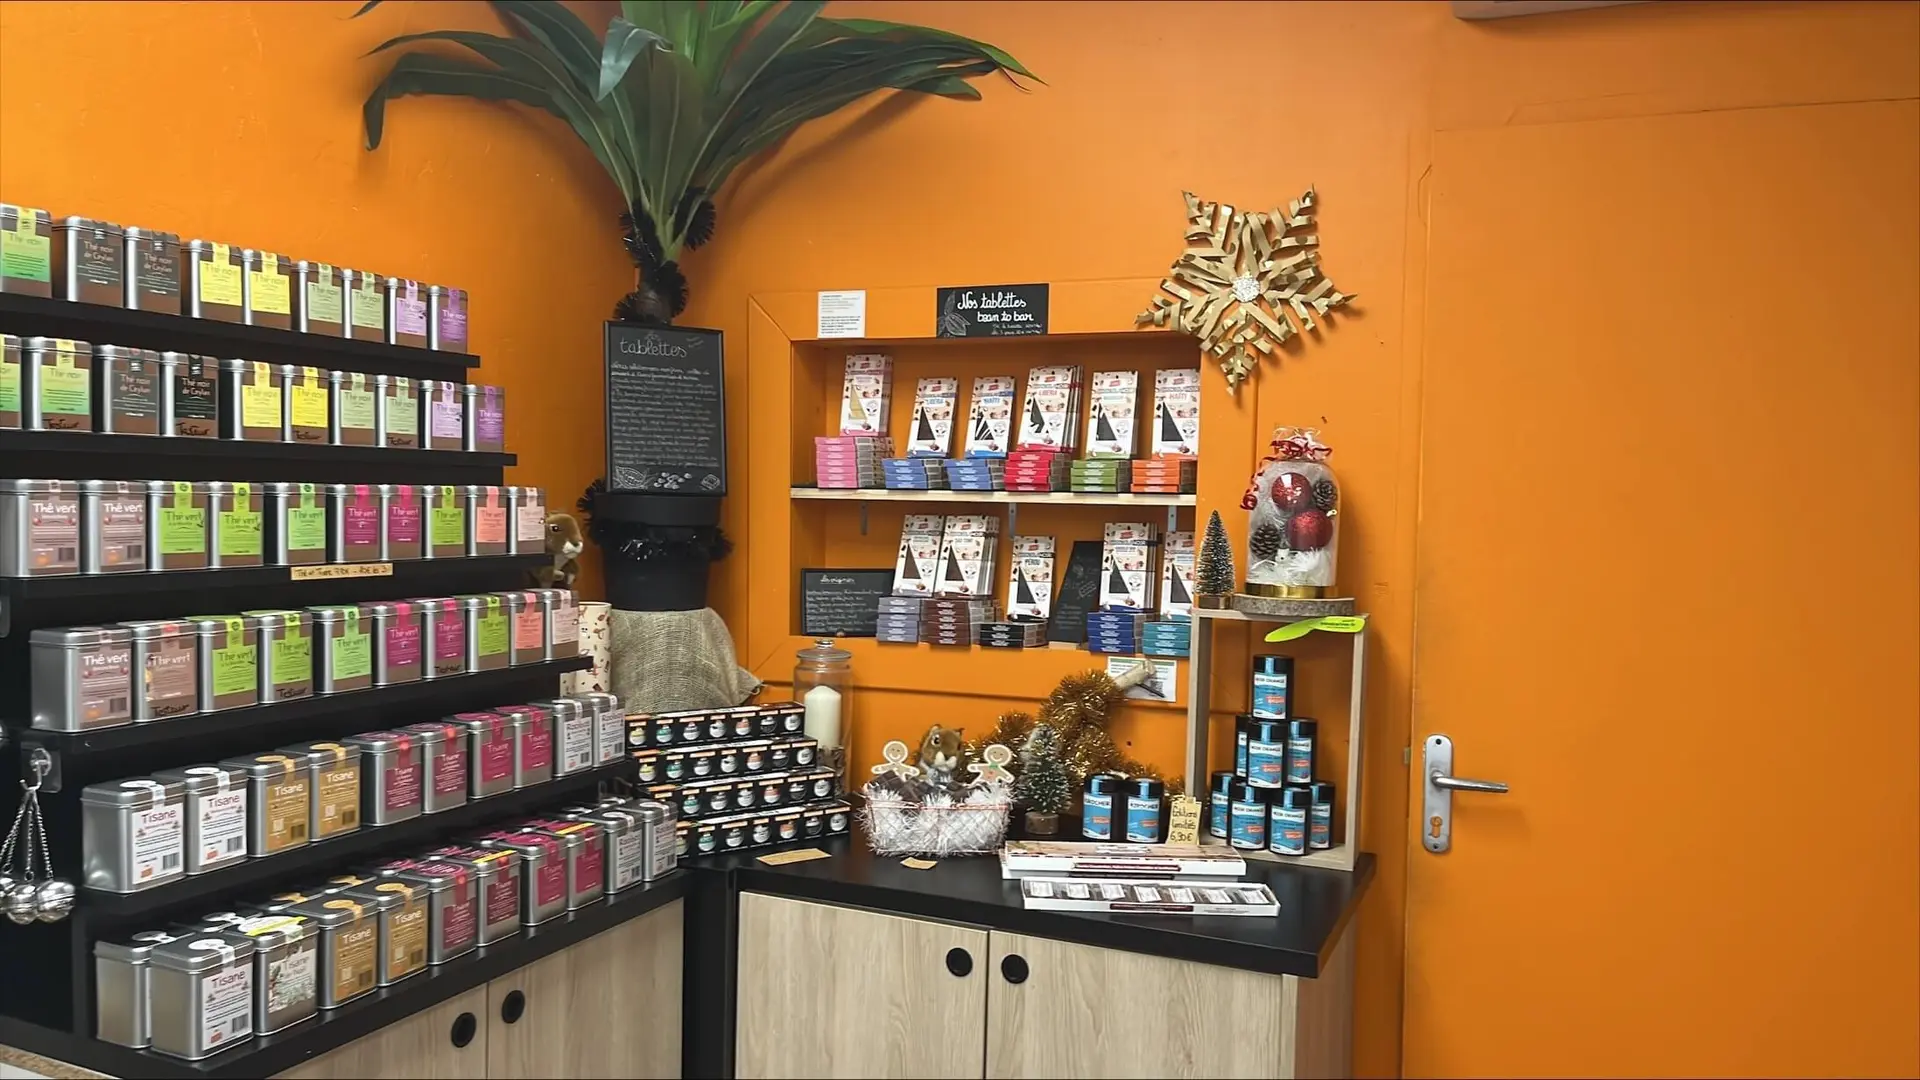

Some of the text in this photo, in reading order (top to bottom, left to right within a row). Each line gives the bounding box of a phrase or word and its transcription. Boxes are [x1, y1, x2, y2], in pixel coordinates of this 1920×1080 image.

[957, 291, 1027, 310] Nos tablettes
[977, 310, 1034, 323] bean to bar
[620, 337, 687, 358] tablettes
[32, 503, 76, 514] Thé vert
[104, 503, 143, 513] Thé vert
[83, 653, 129, 665] Thé vert
[152, 653, 191, 665] Thé vert
[326, 770, 354, 783] Tisane
[274, 783, 303, 796] Tisane
[207, 794, 240, 808] Tisane
[141, 808, 177, 823] Tisane
[394, 909, 422, 924] Tisane
[342, 928, 371, 943] Tisane
[211, 969, 246, 988] Tisane
